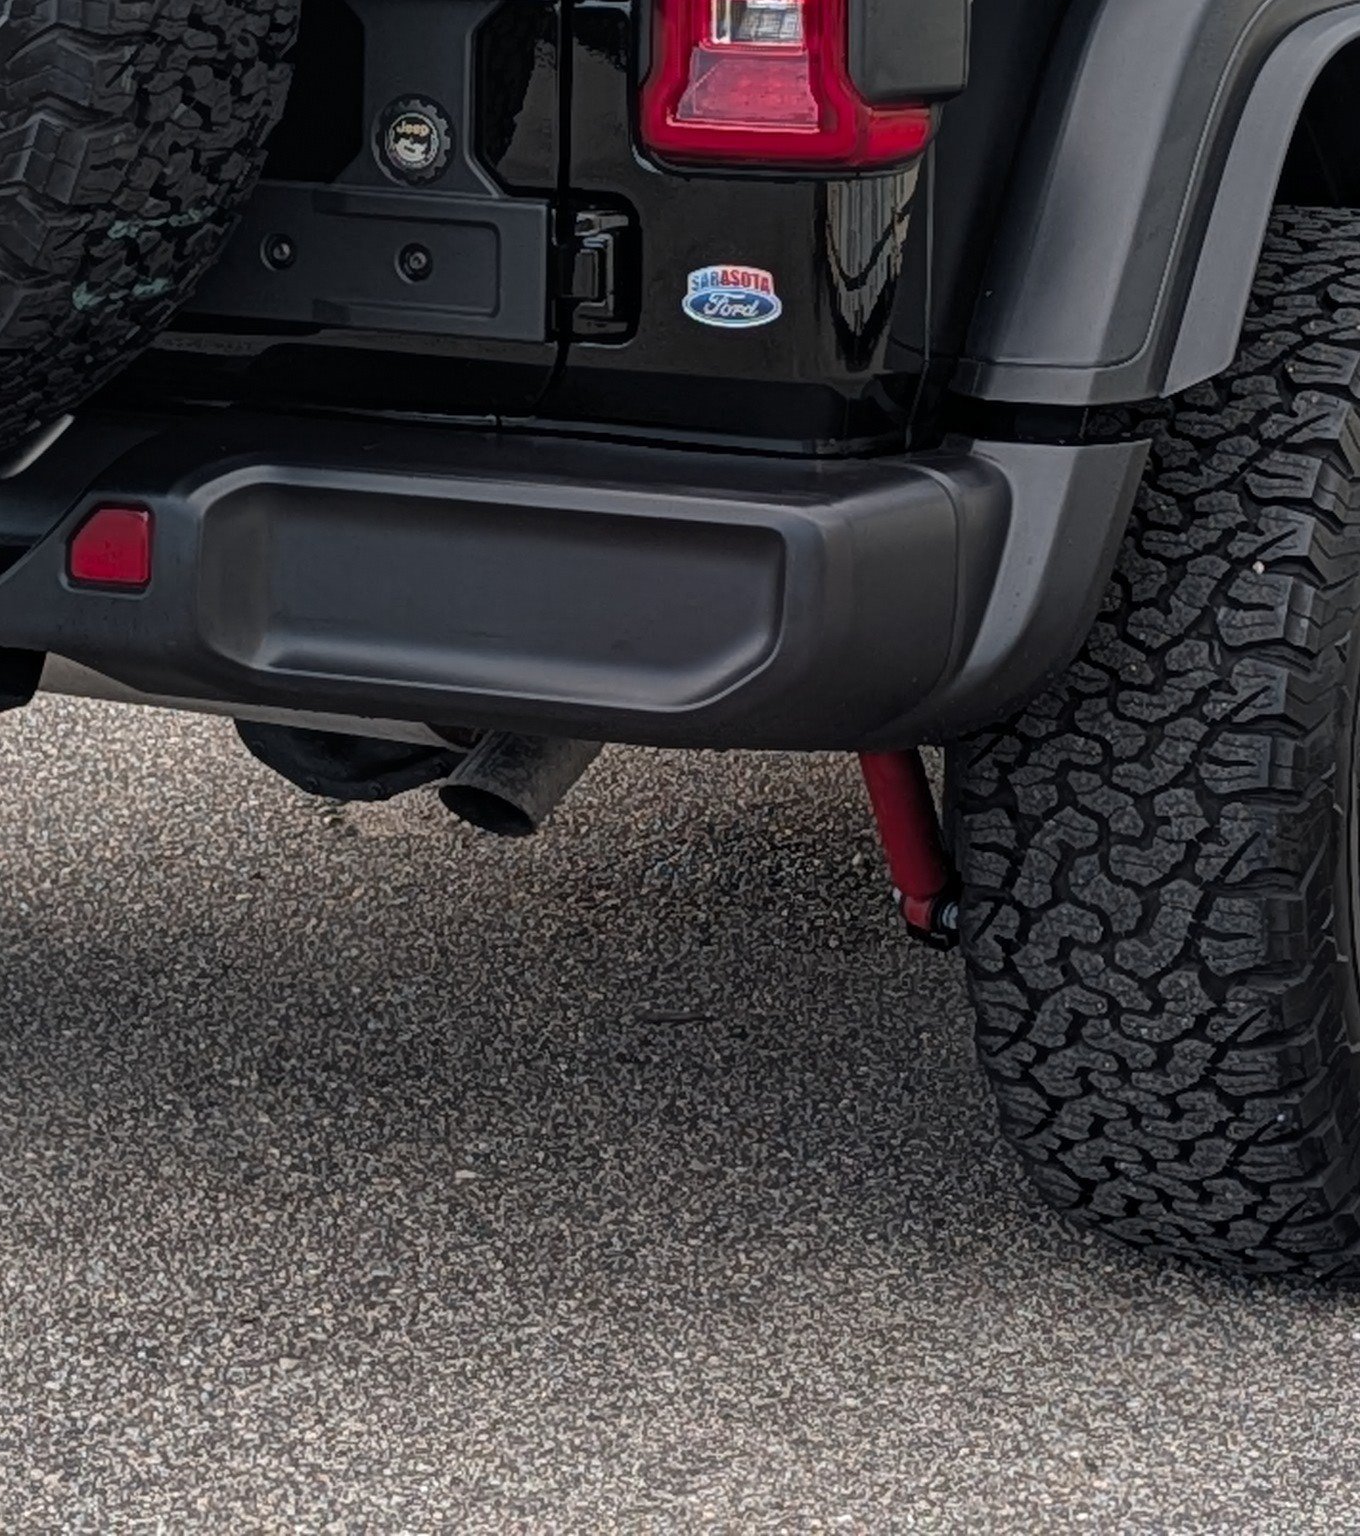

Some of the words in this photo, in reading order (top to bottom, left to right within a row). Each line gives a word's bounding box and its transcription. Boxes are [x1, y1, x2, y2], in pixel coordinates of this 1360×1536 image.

[396, 121, 430, 137] Jeep
[691, 270, 771, 294] SARASOTA
[703, 292, 760, 317] Ford
